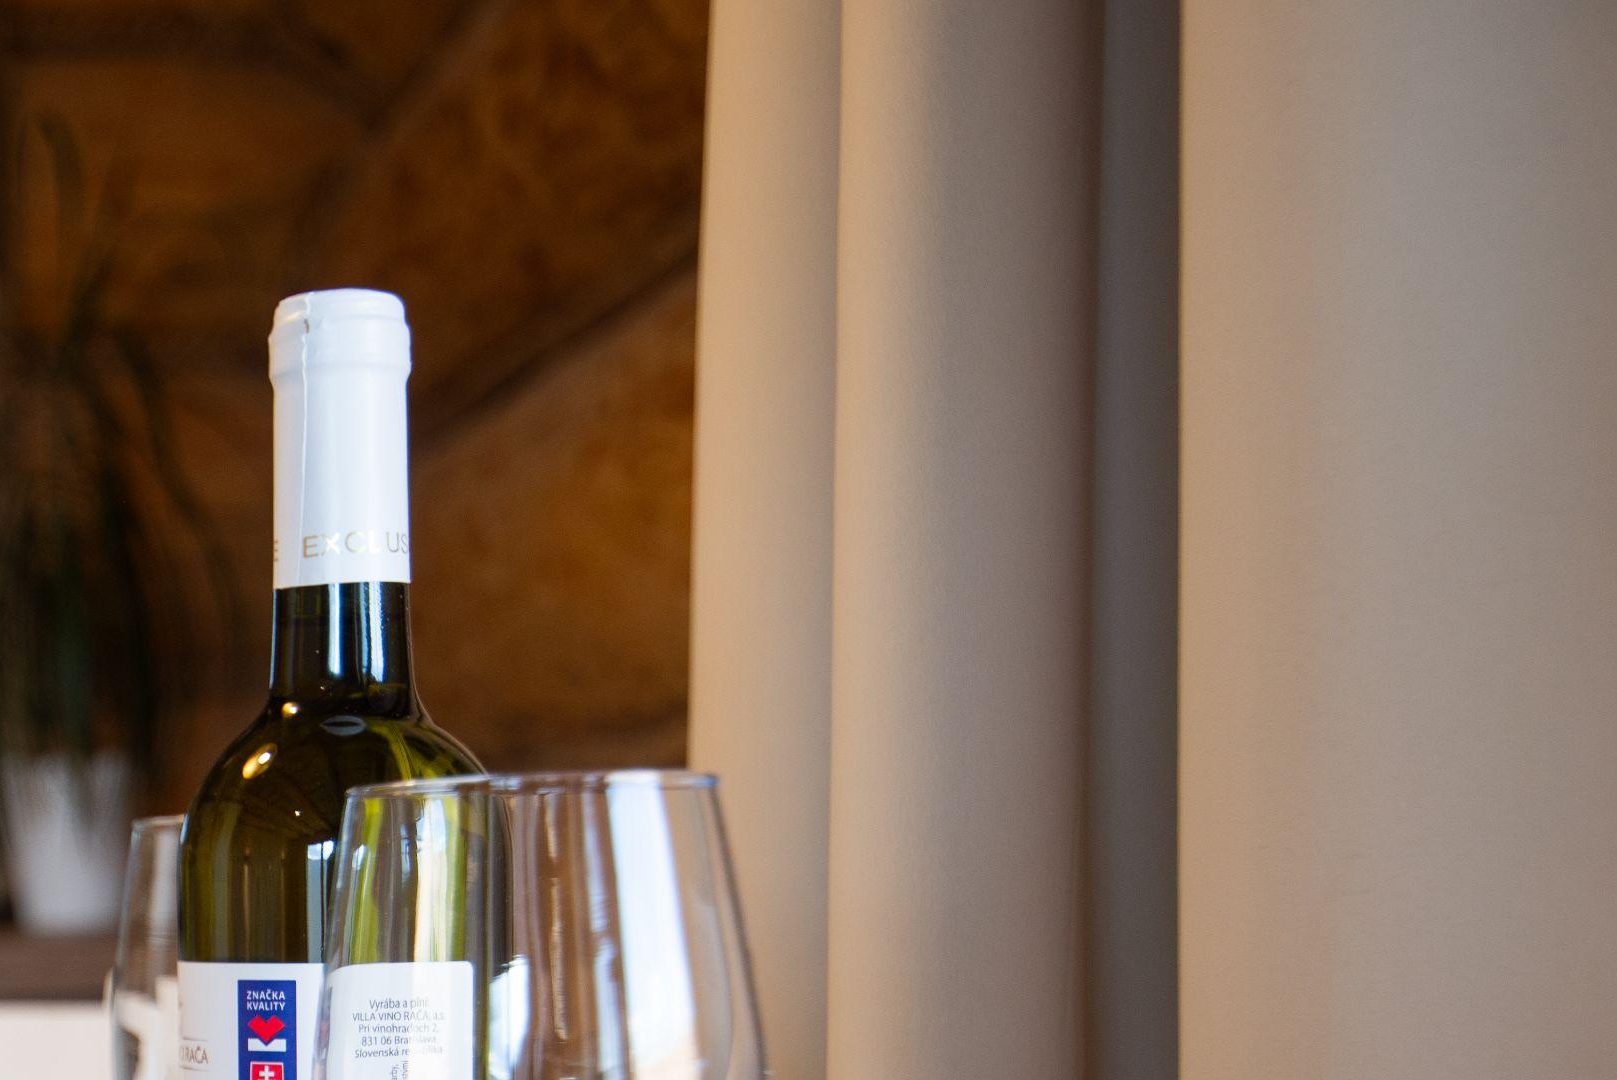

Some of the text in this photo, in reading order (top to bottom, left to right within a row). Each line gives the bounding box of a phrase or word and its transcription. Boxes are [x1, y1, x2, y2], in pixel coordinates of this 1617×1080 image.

[246, 988, 286, 1001] ZNAČKA
[246, 1001, 286, 1012] KVALITY
[369, 998, 400, 1012] Vyrába
[402, 1000, 408, 1009] a
[352, 1012, 376, 1022] VILLA
[379, 1011, 402, 1022] VINO
[358, 1024, 370, 1034] Pri
[361, 1036, 378, 1047] 831
[380, 1036, 392, 1046] 06
[354, 1048, 400, 1059] Slovenská
